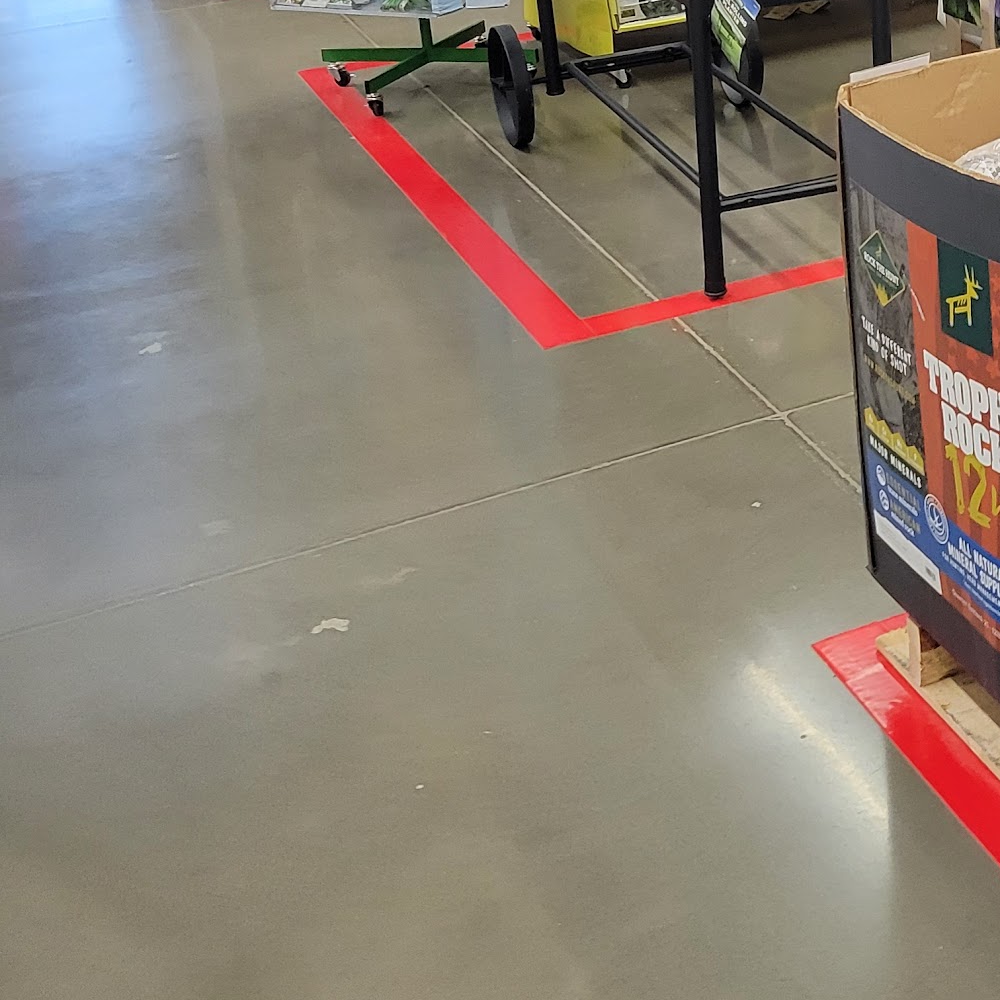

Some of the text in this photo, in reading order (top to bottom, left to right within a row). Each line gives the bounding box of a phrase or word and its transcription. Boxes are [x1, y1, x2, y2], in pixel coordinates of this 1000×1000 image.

[863, 250, 900, 287] ROCK THE HUNT
[861, 314, 875, 336] TAKE
[881, 332, 913, 367] DIFFERENT
[866, 334, 908, 377] KIND OF SHOT
[869, 433, 922, 489] MAJOR MINERALS
[945, 443, 991, 529] 12
[947, 541, 979, 581] MINERAL
[958, 536, 973, 560] ALL
